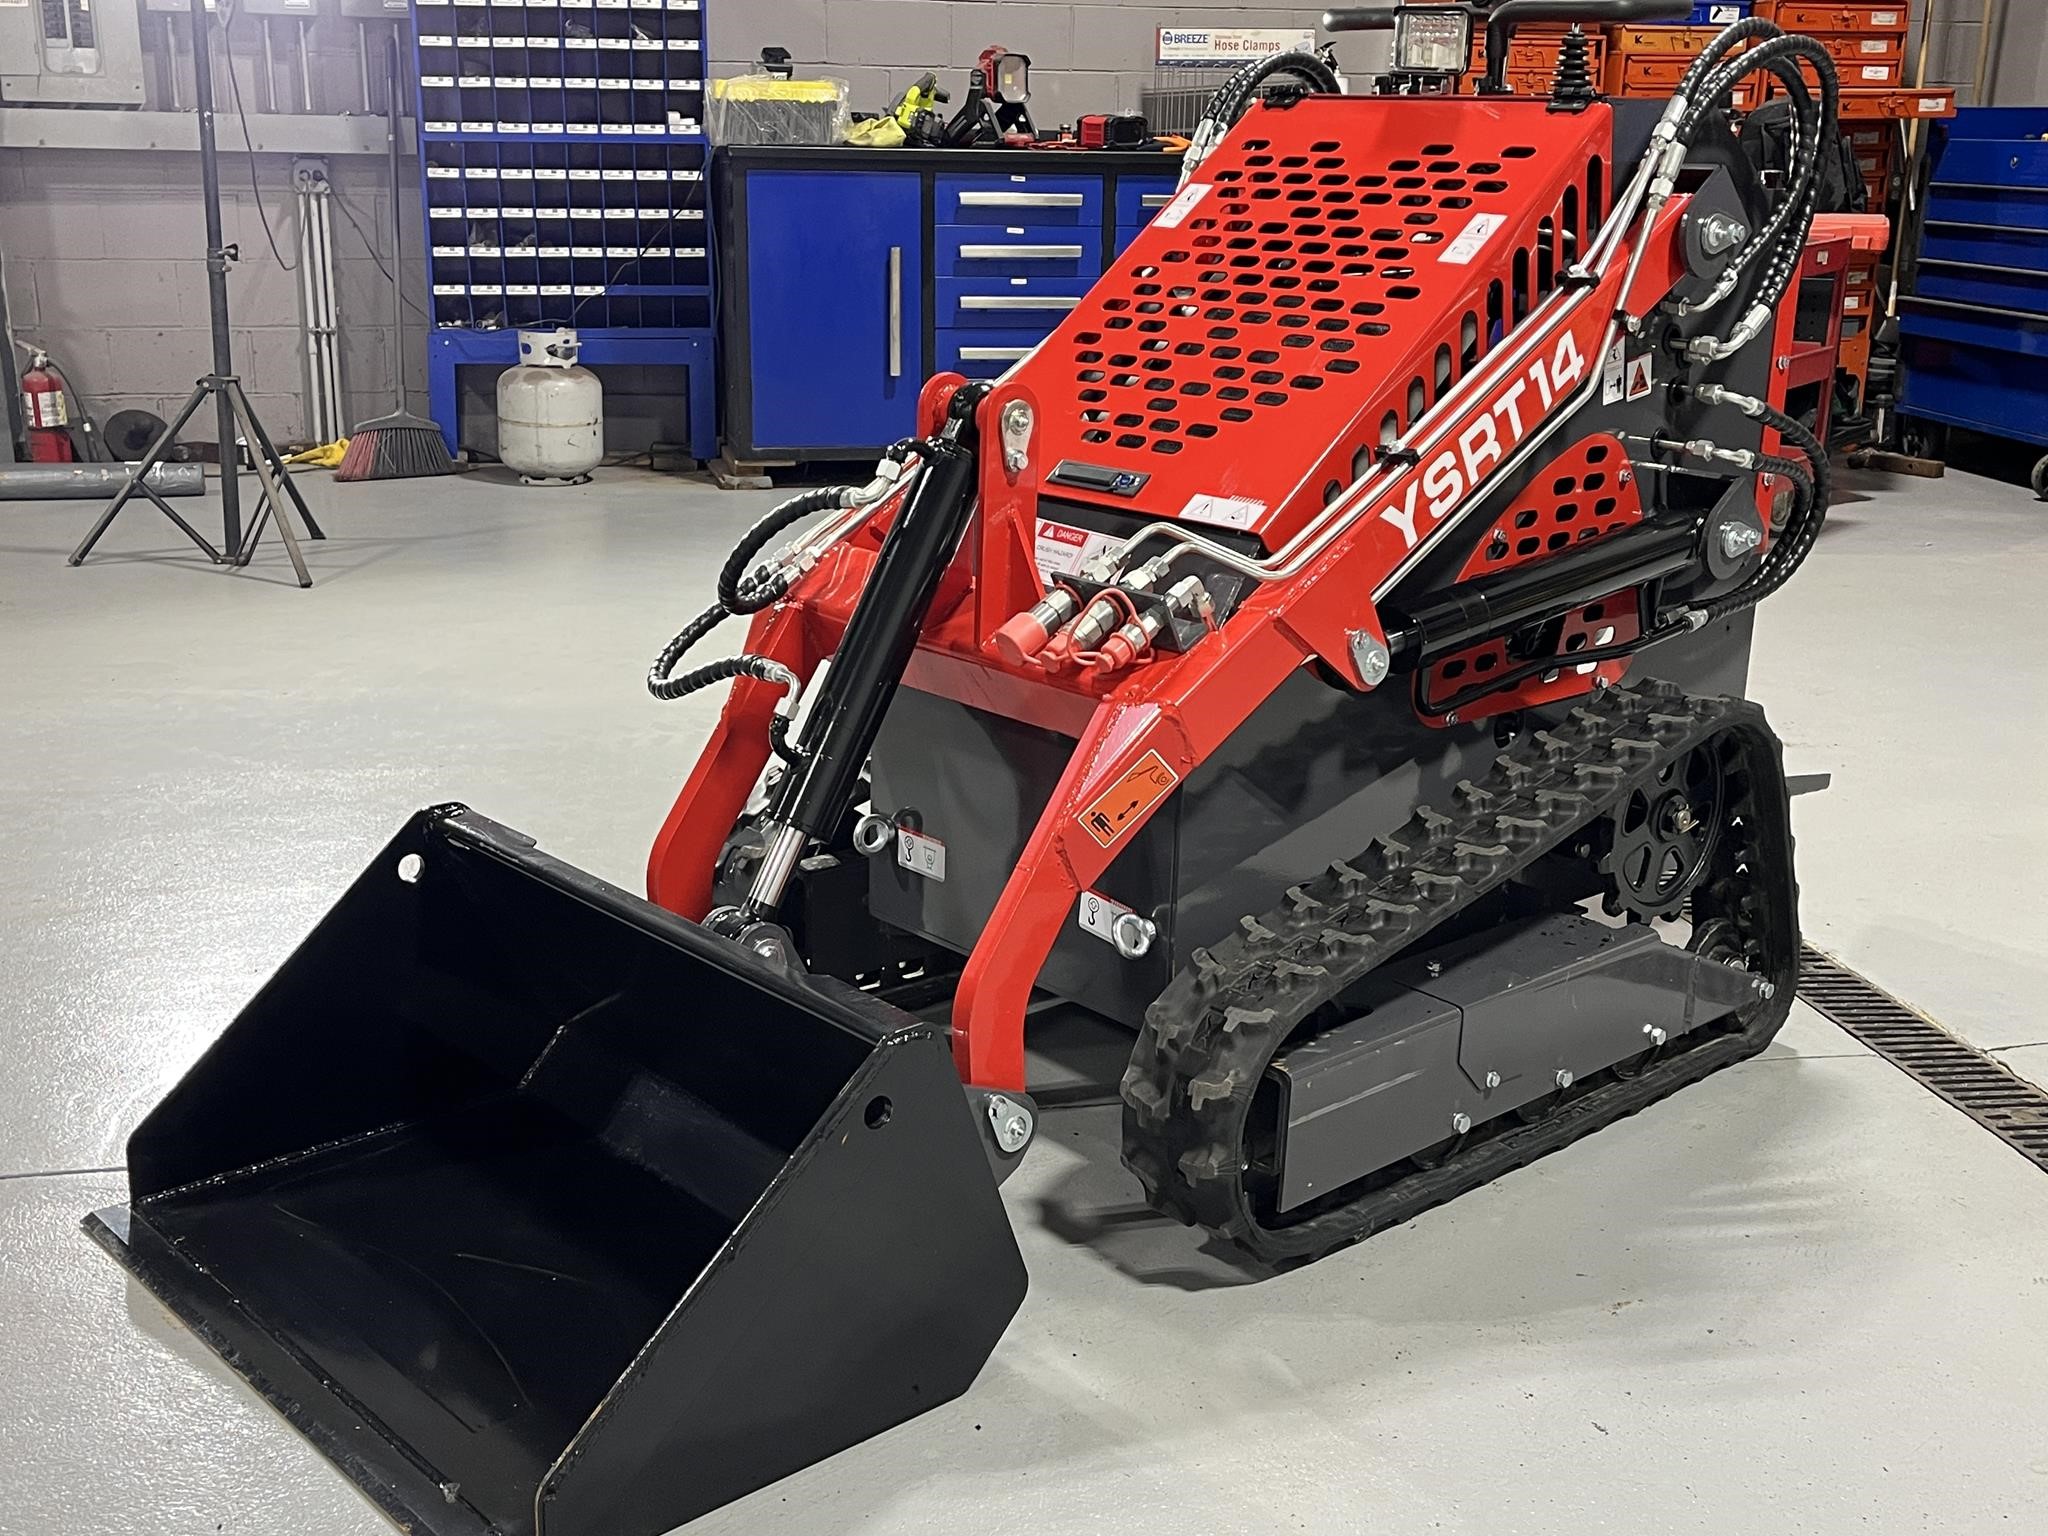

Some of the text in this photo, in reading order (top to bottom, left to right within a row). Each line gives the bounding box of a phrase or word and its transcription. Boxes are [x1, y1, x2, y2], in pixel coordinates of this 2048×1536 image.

[1174, 33, 1208, 44] BREEZE
[1214, 39, 1281, 52] Hose Clamps
[1379, 329, 1585, 549] YSRT14
[1057, 530, 1083, 543] DANGER
